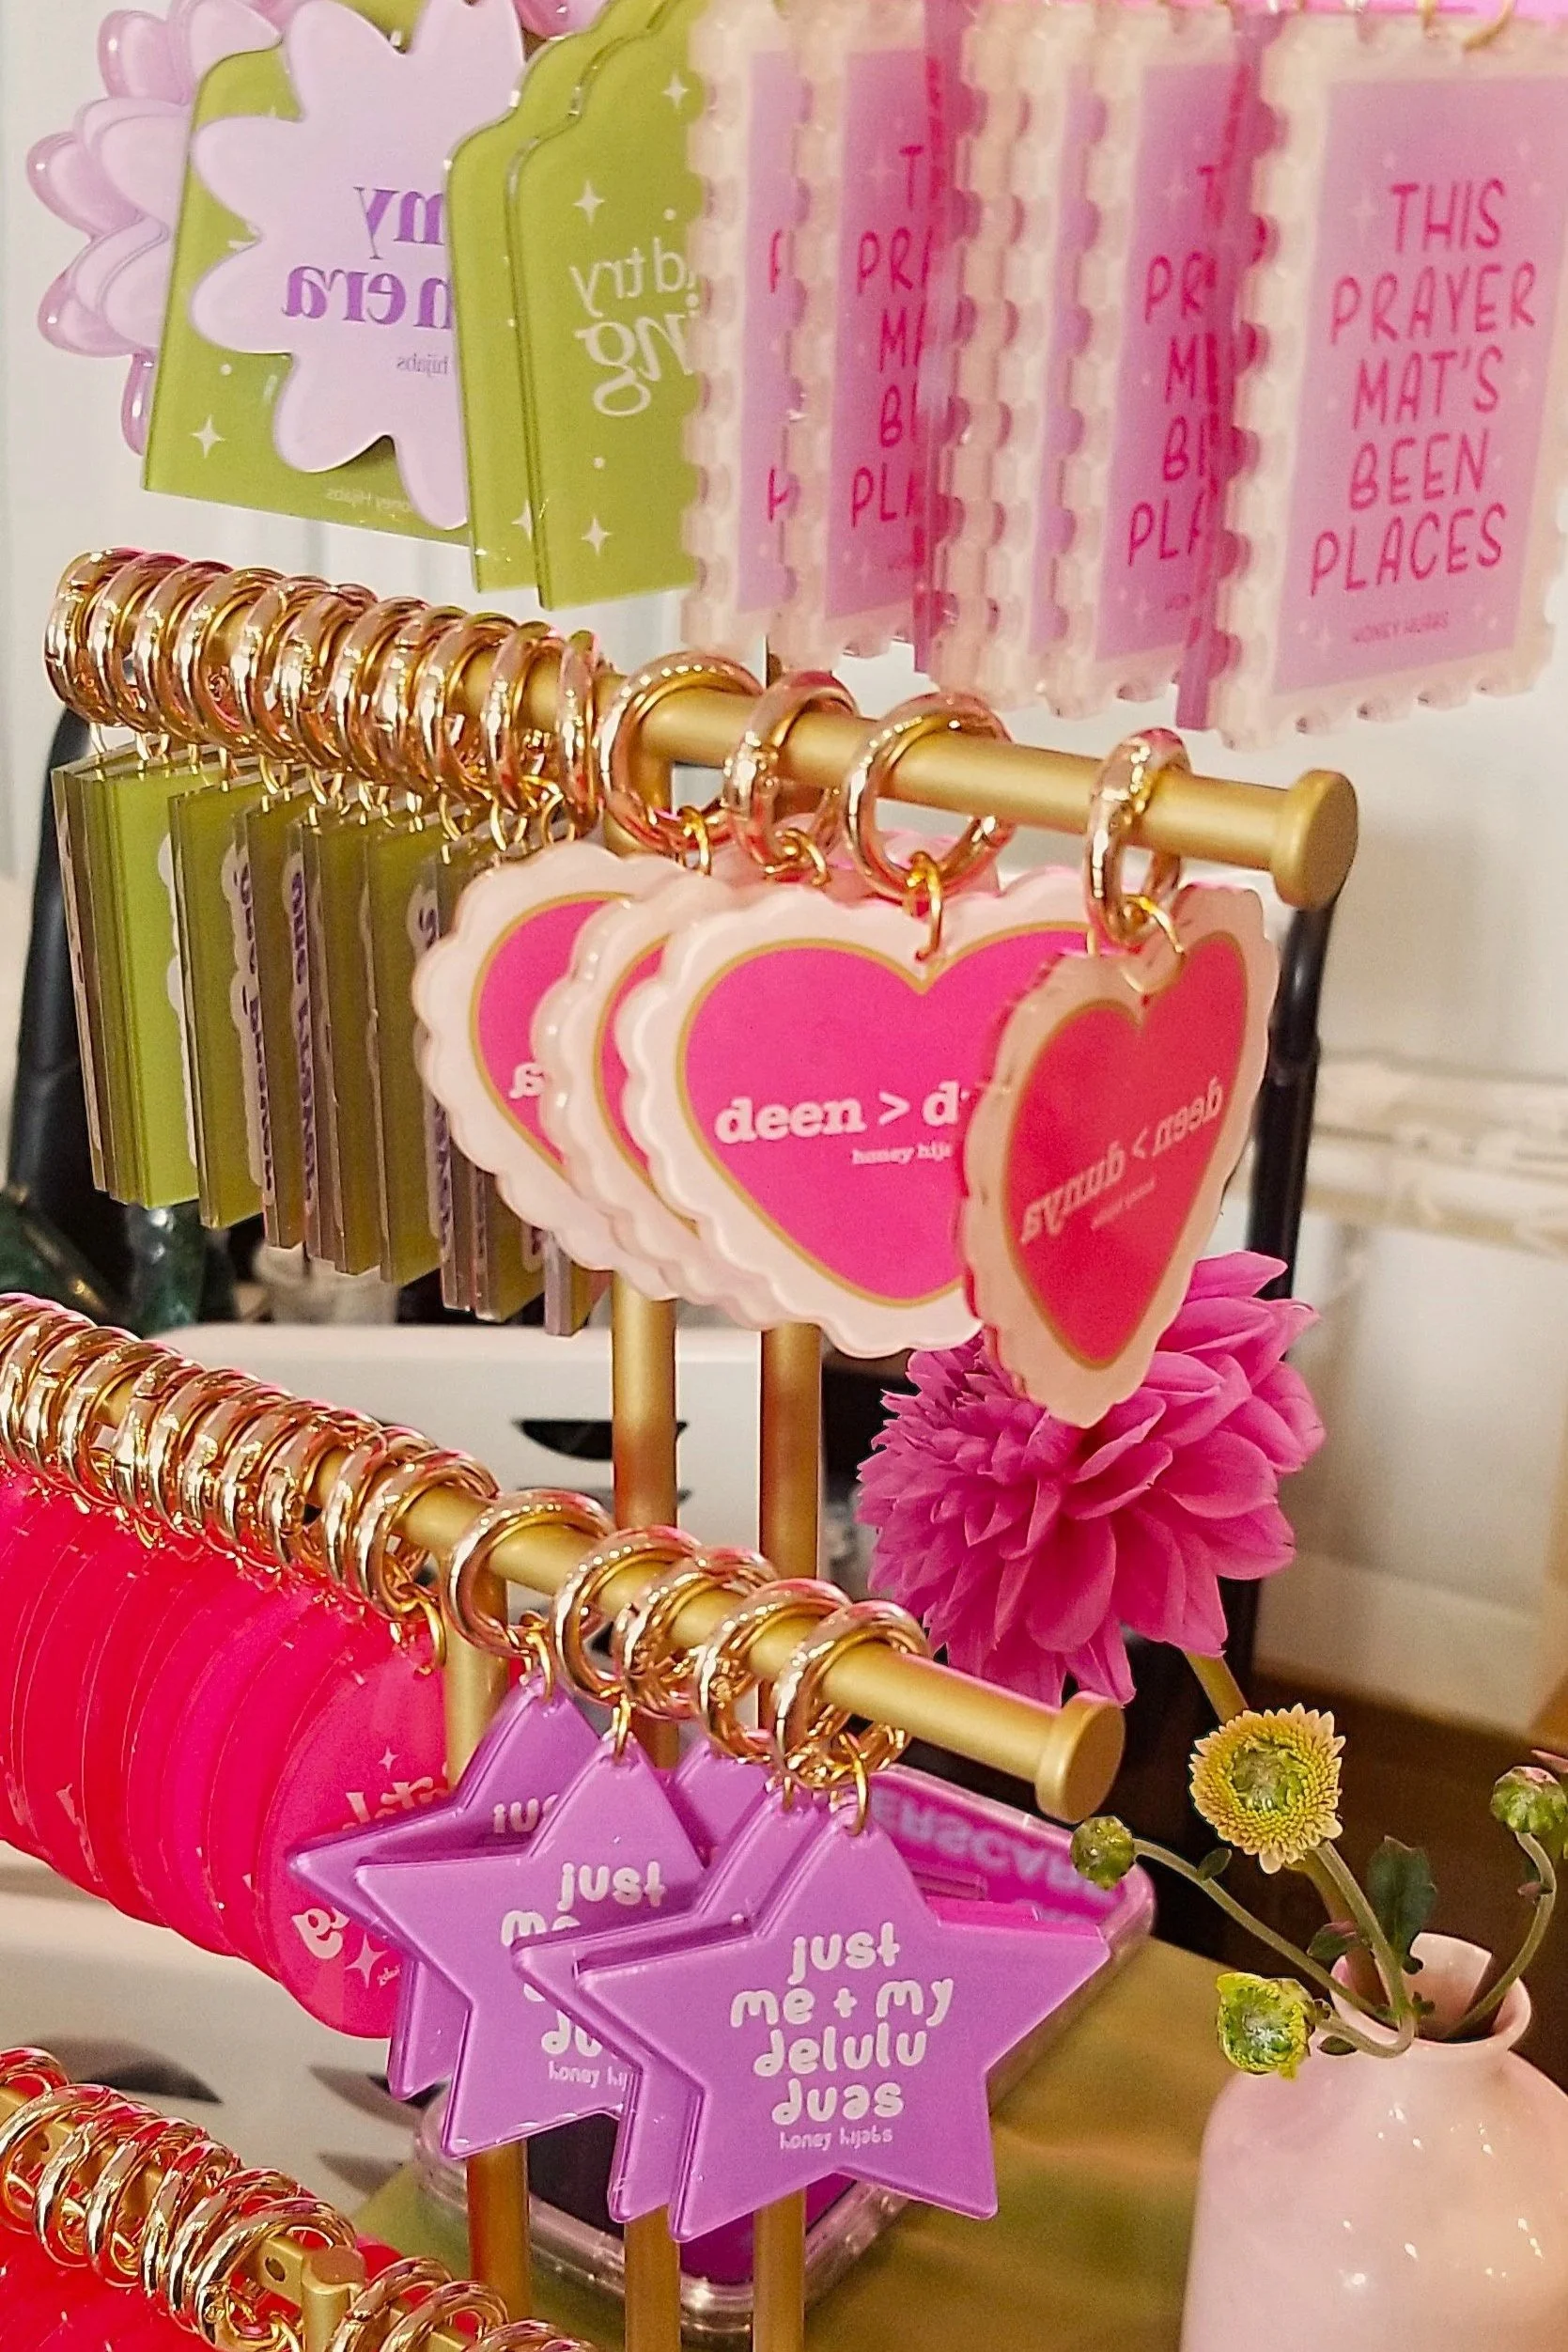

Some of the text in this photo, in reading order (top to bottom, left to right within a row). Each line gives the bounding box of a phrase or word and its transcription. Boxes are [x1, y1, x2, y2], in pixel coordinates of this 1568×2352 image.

[1390, 178, 1506, 254] THIS
[1328, 260, 1536, 345] PRAYER
[1353, 344, 1503, 430] MAT'S
[1349, 428, 1490, 510] BEEN
[1310, 502, 1507, 598] PLACES
[714, 1095, 868, 1145] deen
[921, 1080, 970, 1128] d
[850, 1145, 915, 1165] honey
[557, 1860, 668, 1913] just
[787, 1921, 901, 1986] just
[730, 1986, 815, 2029] me
[876, 1977, 955, 2028] my
[549, 2059, 600, 2090] honey
[753, 2021, 928, 2078] delulu
[771, 2077, 905, 2126] duas
[779, 2124, 893, 2152] honey hijabs
